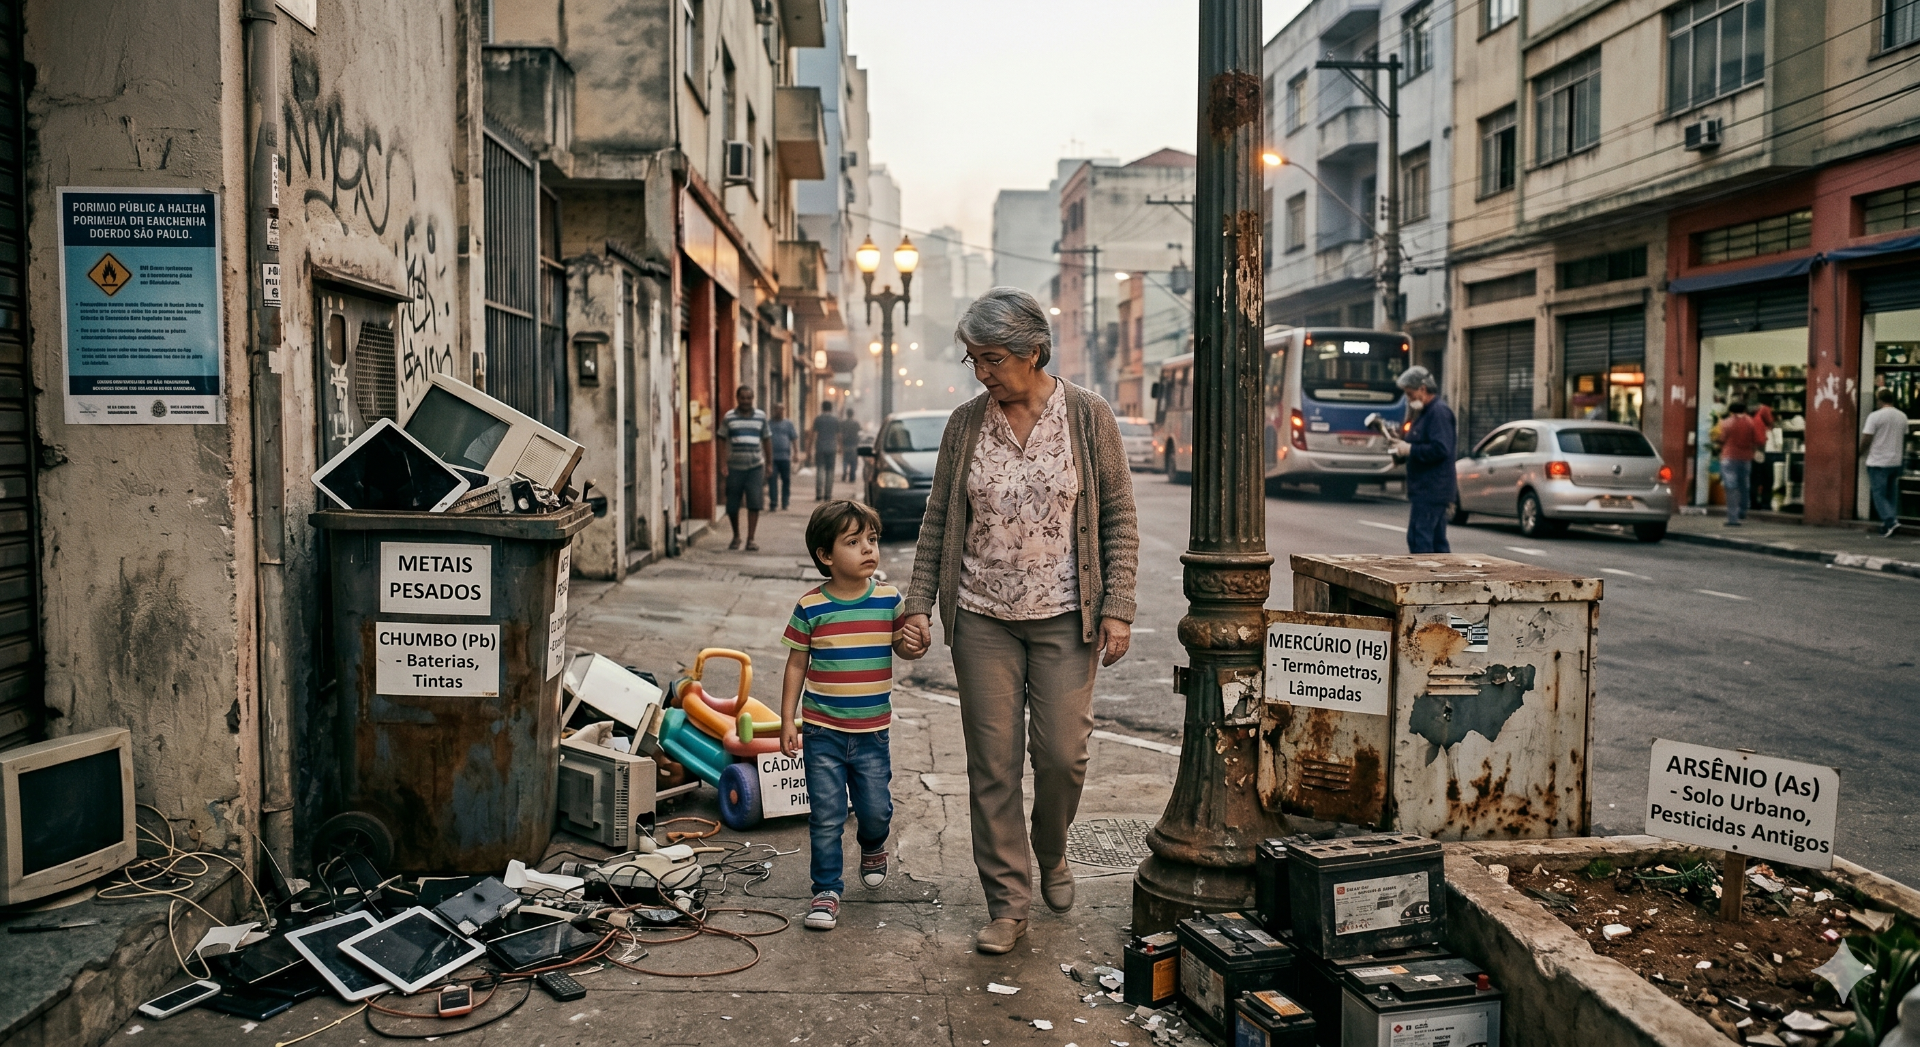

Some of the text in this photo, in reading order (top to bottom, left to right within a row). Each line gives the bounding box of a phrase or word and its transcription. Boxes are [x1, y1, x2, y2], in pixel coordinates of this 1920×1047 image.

[158, 204, 165, 212] A
[90, 229, 130, 238] DOERDO
[399, 555, 472, 573] METAIS
[390, 582, 481, 600] PESADOS
[380, 632, 496, 651] CHUMBO (Pb)
[1269, 633, 1387, 661] MERCÚRIO (Hg)
[407, 654, 479, 671] Baterias,
[412, 674, 463, 688] Tintas
[1289, 681, 1361, 702] Lâmpadas
[1666, 755, 1819, 802] ARSÊNIO (As)
[1682, 785, 1724, 807] Solo
[1730, 793, 1811, 826] Urbano,
[1650, 804, 1829, 853] Pesticidas Antigos
